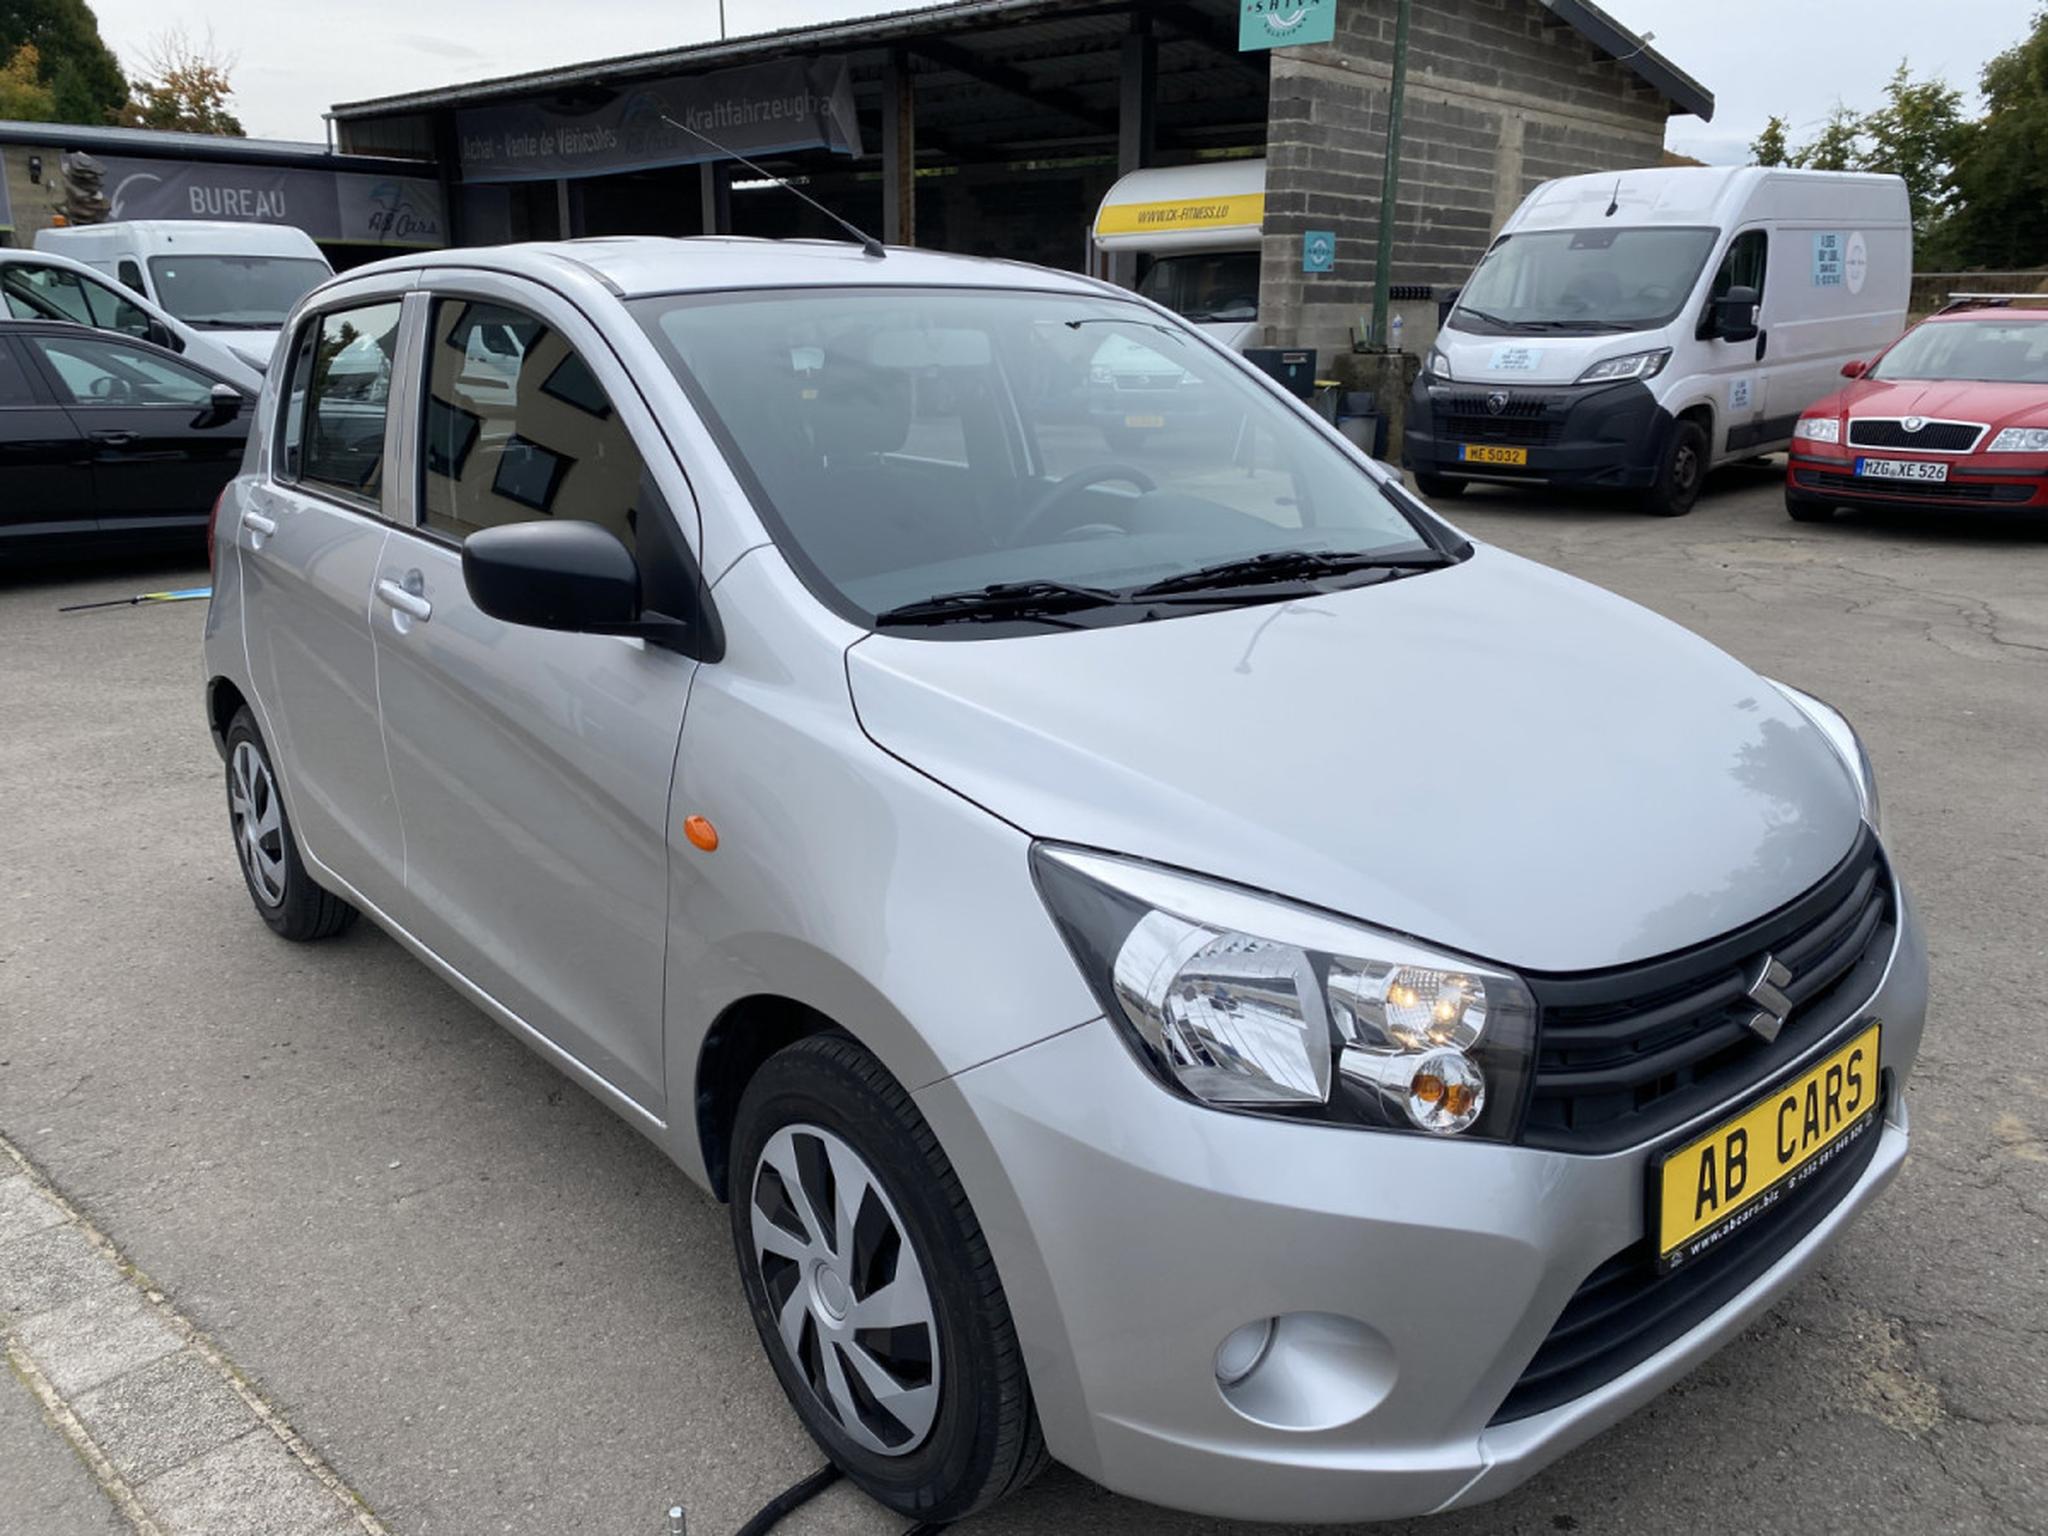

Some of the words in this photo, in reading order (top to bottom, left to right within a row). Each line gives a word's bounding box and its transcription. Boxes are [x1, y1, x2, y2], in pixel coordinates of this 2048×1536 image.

[540, 130, 555, 156] de
[188, 186, 287, 218] BUREAU
[1899, 461, 1917, 477] XE
[1919, 463, 1946, 480] 526
[1694, 1127, 1748, 1221] AB
[1776, 1048, 1863, 1164] CARS
[1690, 1189, 1780, 1256] www.abcars.biz
